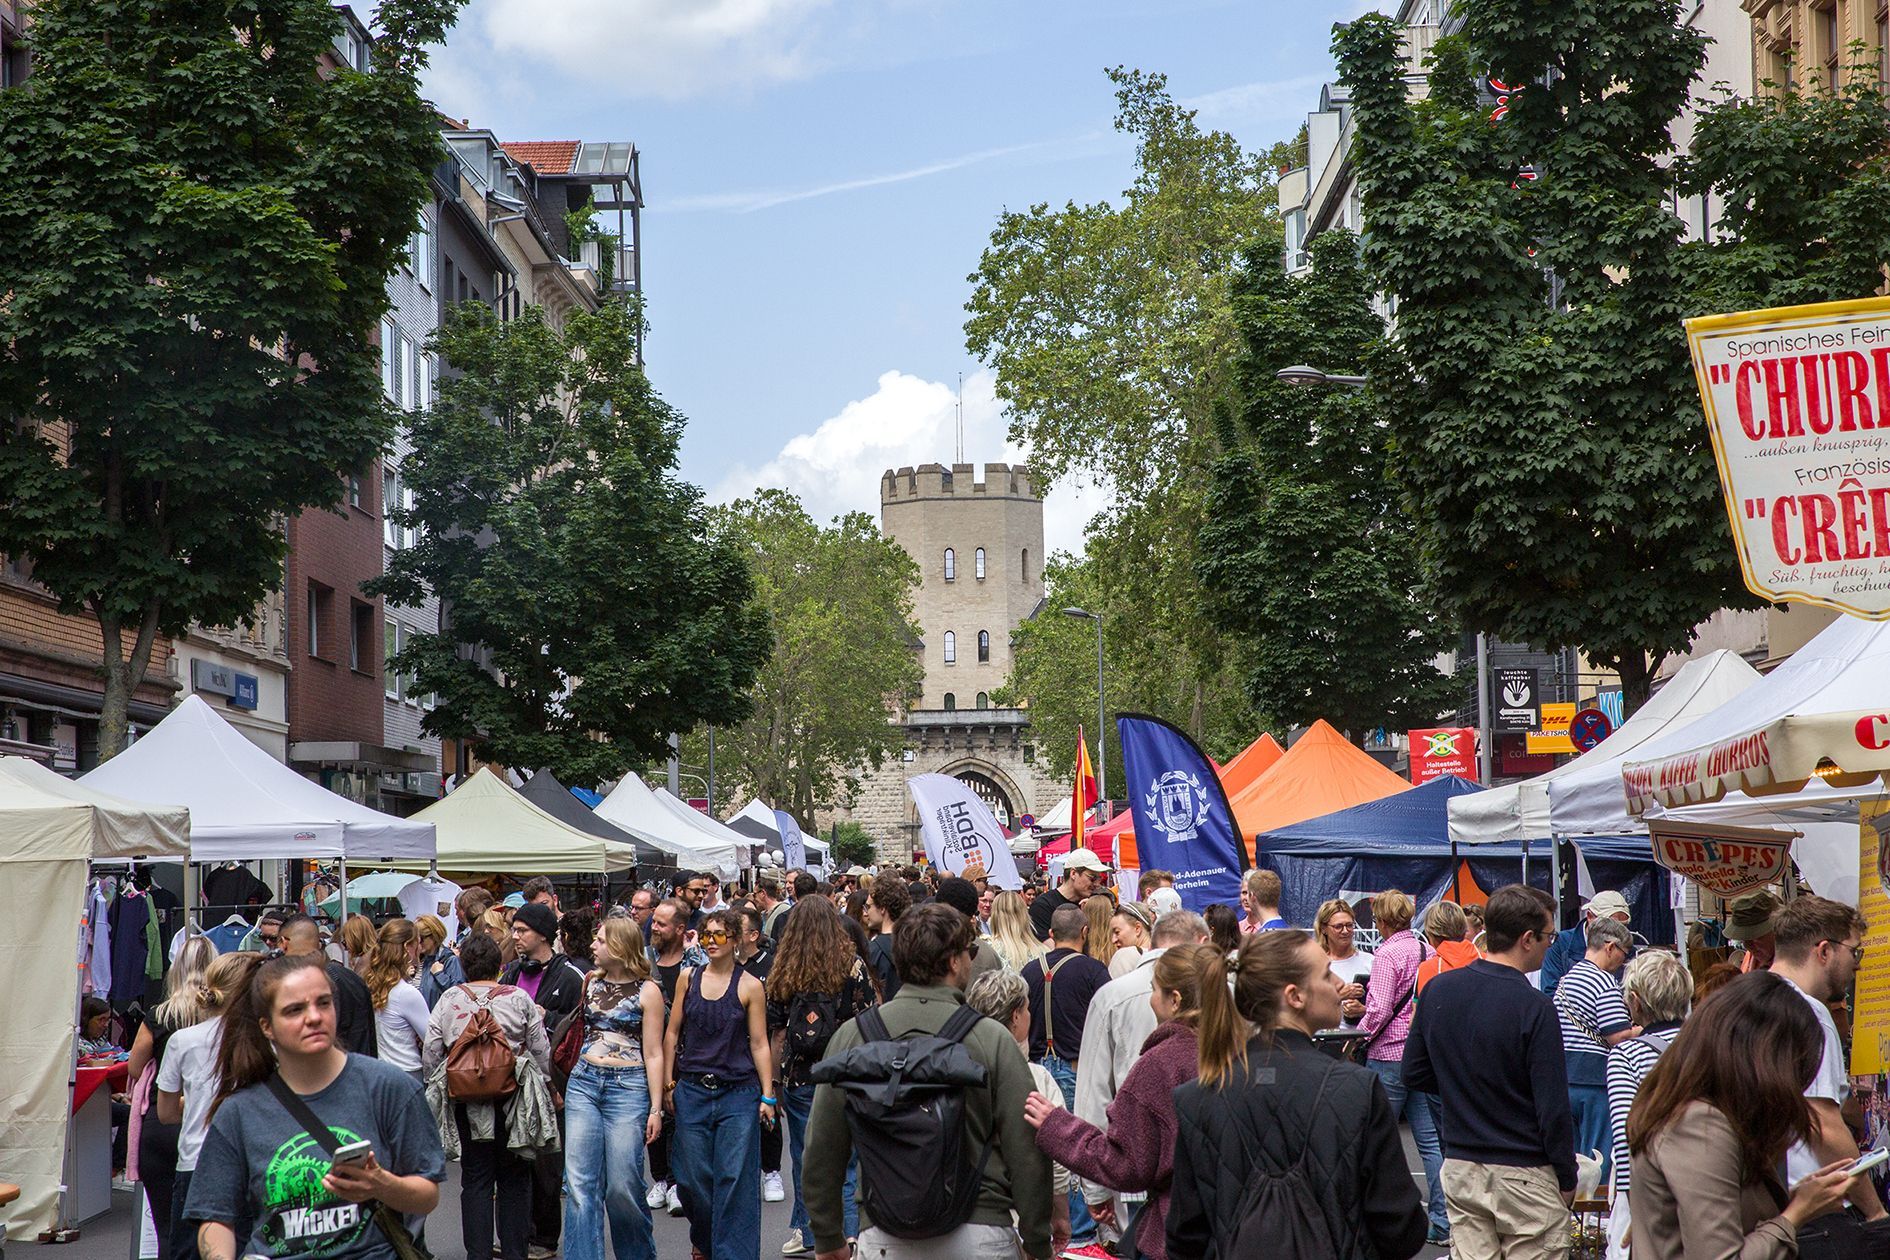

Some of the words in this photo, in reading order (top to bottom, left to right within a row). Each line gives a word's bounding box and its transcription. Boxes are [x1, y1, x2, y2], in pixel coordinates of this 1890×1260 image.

[1727, 332, 1844, 360] Spanisches
[1421, 768, 1441, 776] außer
[1442, 766, 1468, 774] Betrieb!
[1426, 760, 1461, 768] Haltestelle
[1660, 752, 1700, 791] KAFFEE
[1707, 730, 1771, 778] CHURROS
[1665, 837, 1777, 869] CRÊPES
[1694, 867, 1736, 881] nutella
